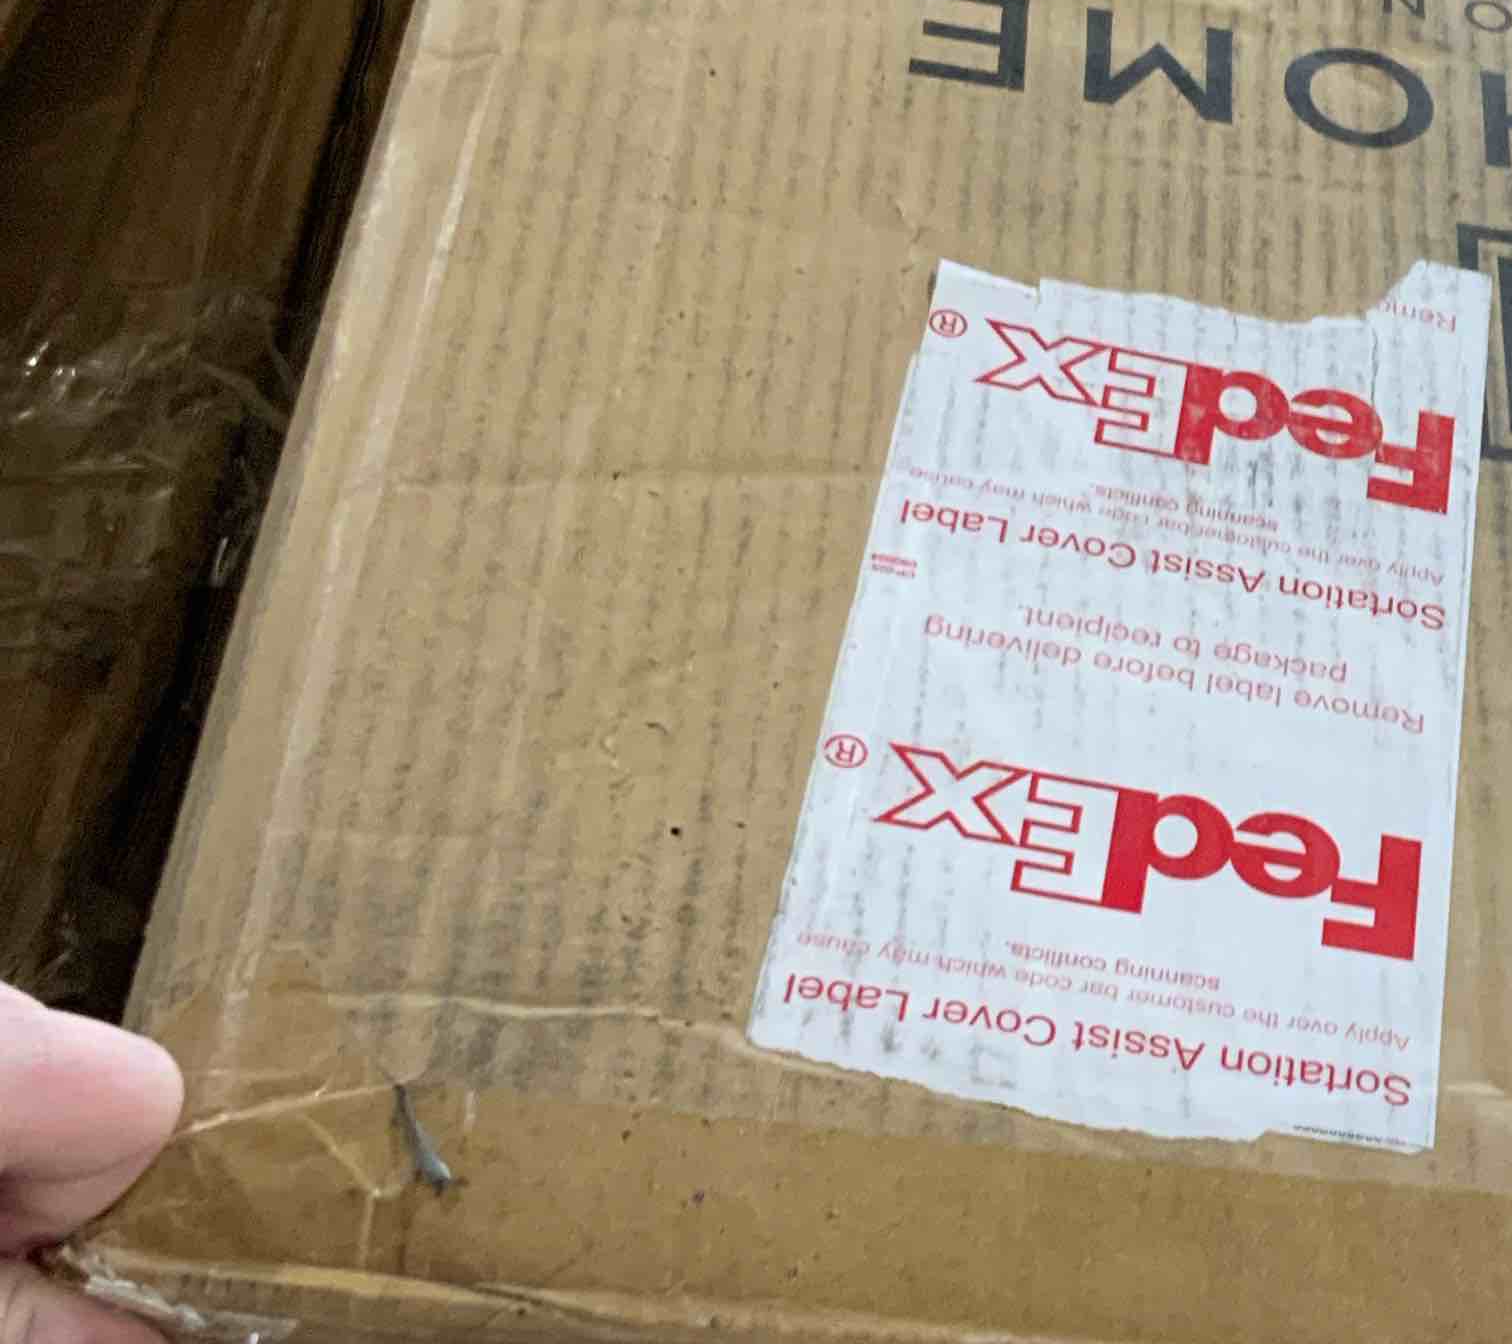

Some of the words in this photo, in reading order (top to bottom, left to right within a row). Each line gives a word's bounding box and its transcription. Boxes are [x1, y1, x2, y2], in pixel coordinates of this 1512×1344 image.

[974, 318, 1455, 515] FedEx
[899, 498, 1009, 545] Label
[1018, 524, 1137, 570] Cover
[1150, 548, 1265, 594] Assist
[1277, 574, 1445, 632] Sortation
[921, 613, 1082, 667] delivering
[1172, 634, 1200, 659] to
[1092, 650, 1195, 691] before
[1212, 642, 1348, 685] package
[1205, 672, 1282, 709] label
[1292, 688, 1424, 736] Remove
[872, 742, 1422, 962] FedEx
[877, 941, 932, 967] may
[936, 954, 1006, 985] which
[1115, 957, 1221, 993] scanning
[782, 972, 911, 1023] Label
[1015, 967, 1073, 992] code
[1079, 978, 1120, 1002] bar
[921, 996, 1057, 1047] Cover
[1124, 989, 1235, 1020] customer
[1241, 1006, 1279, 1029] the
[1286, 1014, 1338, 1036] over
[1070, 1020, 1206, 1072] Assist
[1344, 1021, 1411, 1052] Apply
[1219, 1045, 1412, 1108] Sortation
